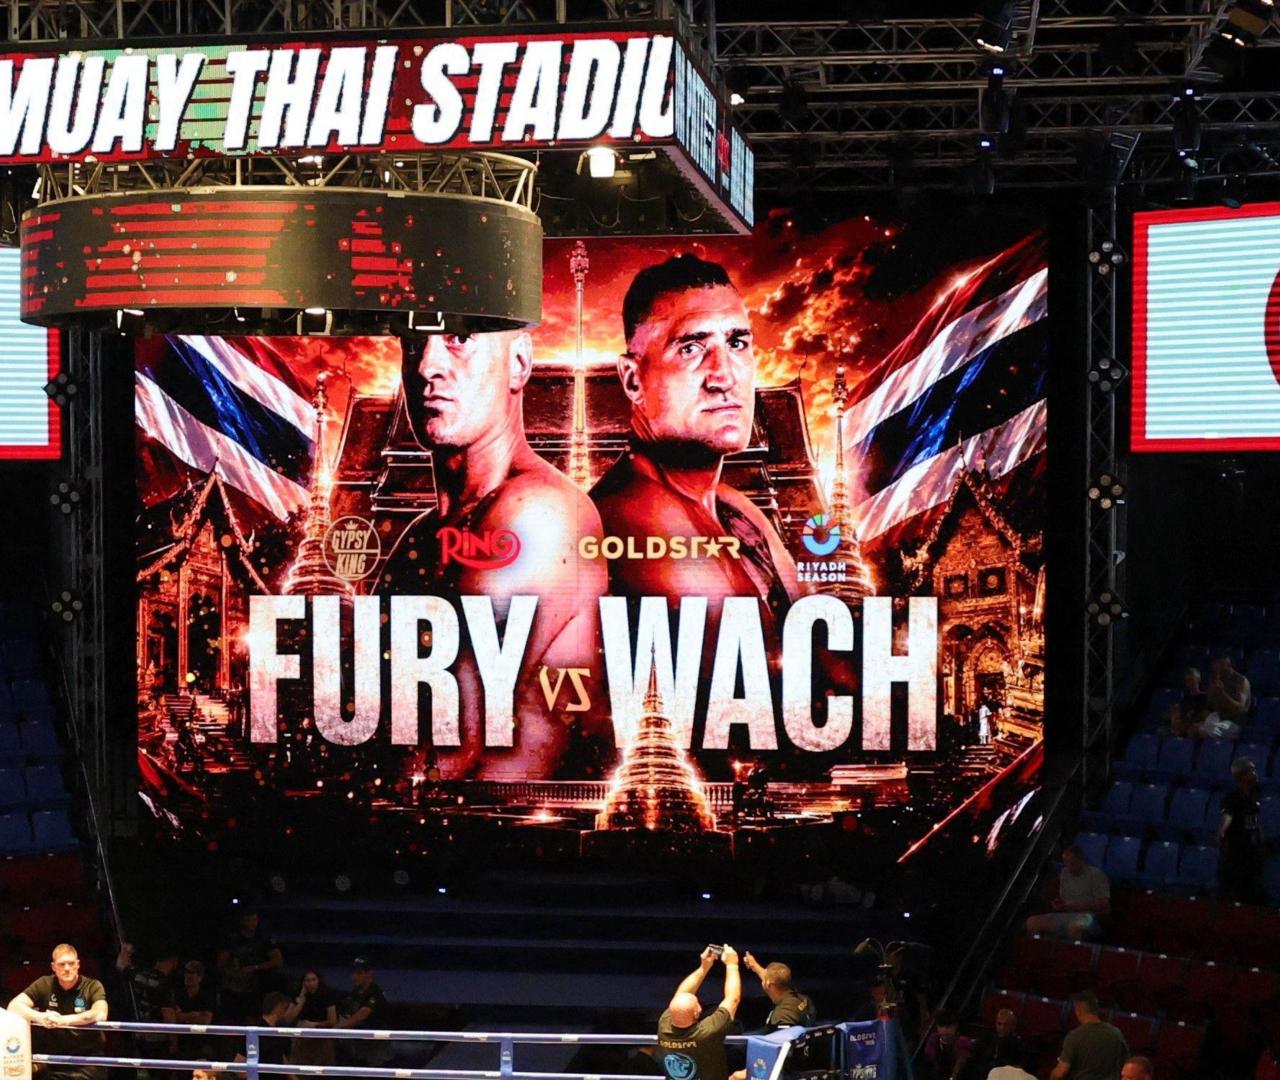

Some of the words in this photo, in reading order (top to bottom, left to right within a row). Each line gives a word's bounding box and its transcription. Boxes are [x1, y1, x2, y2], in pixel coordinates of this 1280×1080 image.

[223, 46, 397, 148] THAI
[412, 36, 673, 140] STADIU
[331, 529, 371, 550] GYPSY
[335, 553, 367, 574] KING
[797, 562, 846, 571] RIYADH
[797, 572, 846, 583] SEASON
[247, 595, 538, 747] FURY
[538, 665, 592, 713] VS
[601, 595, 938, 752] WACH
